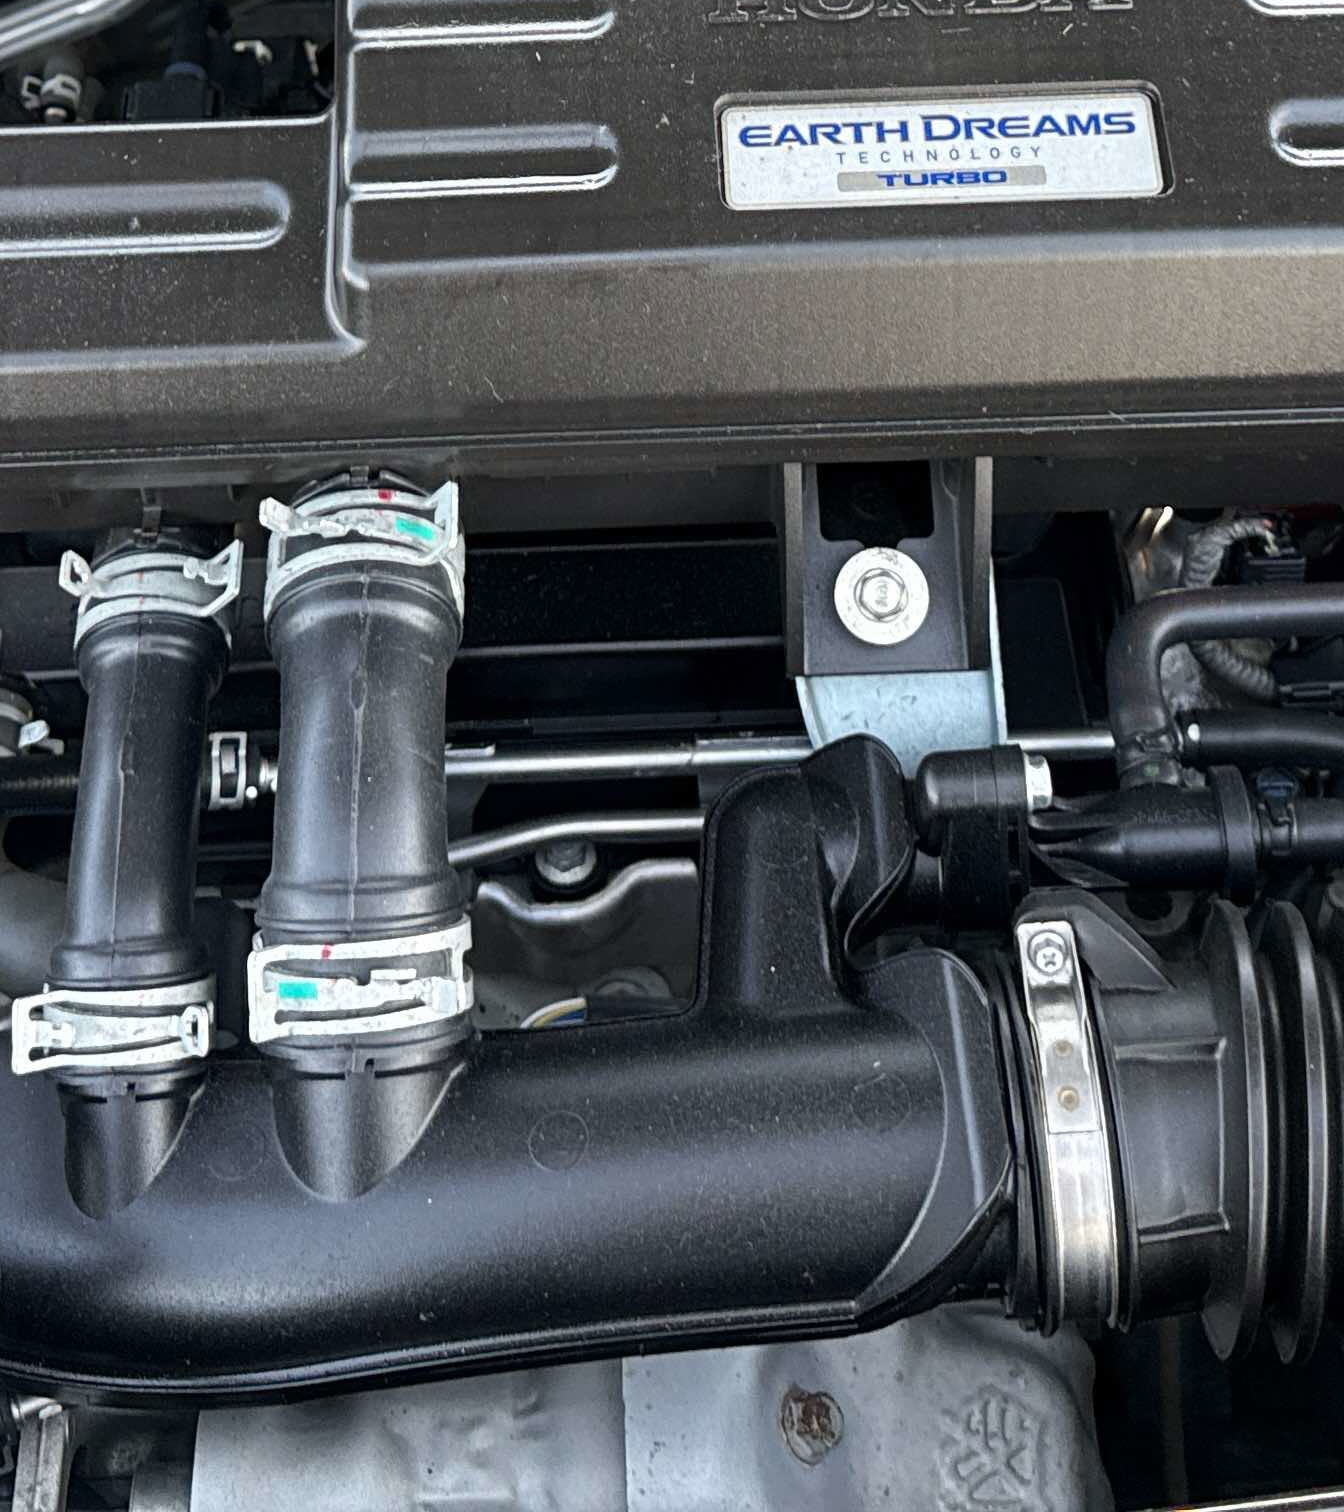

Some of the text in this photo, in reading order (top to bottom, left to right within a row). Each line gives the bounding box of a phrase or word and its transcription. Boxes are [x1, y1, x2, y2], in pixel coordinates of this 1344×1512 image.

[738, 112, 1136, 148] EARTH DREAMS
[836, 145, 1042, 165] TECHNOLOGY
[876, 169, 1008, 188] TURBO
